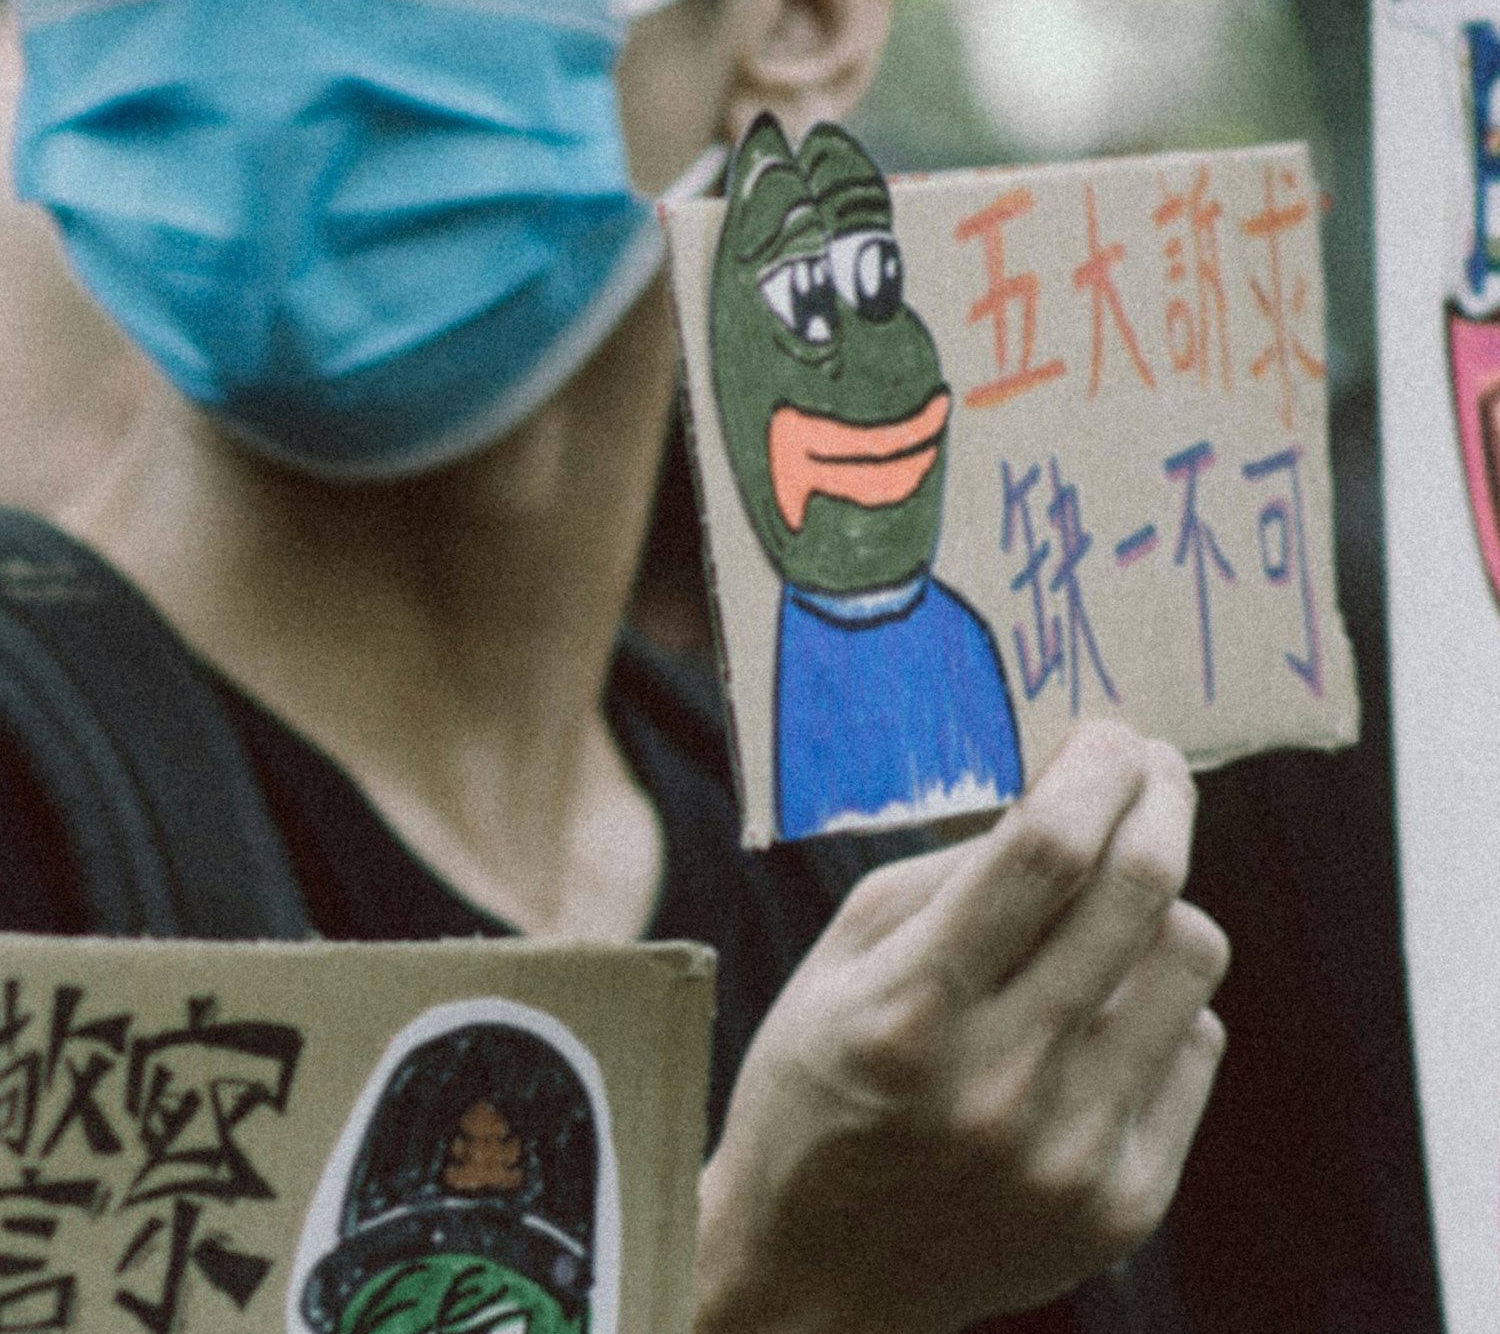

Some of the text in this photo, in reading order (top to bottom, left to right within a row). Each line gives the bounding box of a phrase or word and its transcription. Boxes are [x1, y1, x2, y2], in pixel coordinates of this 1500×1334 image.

[953, 164, 1332, 429] 五大訴求
[998, 437, 1325, 715] 缺一不可
